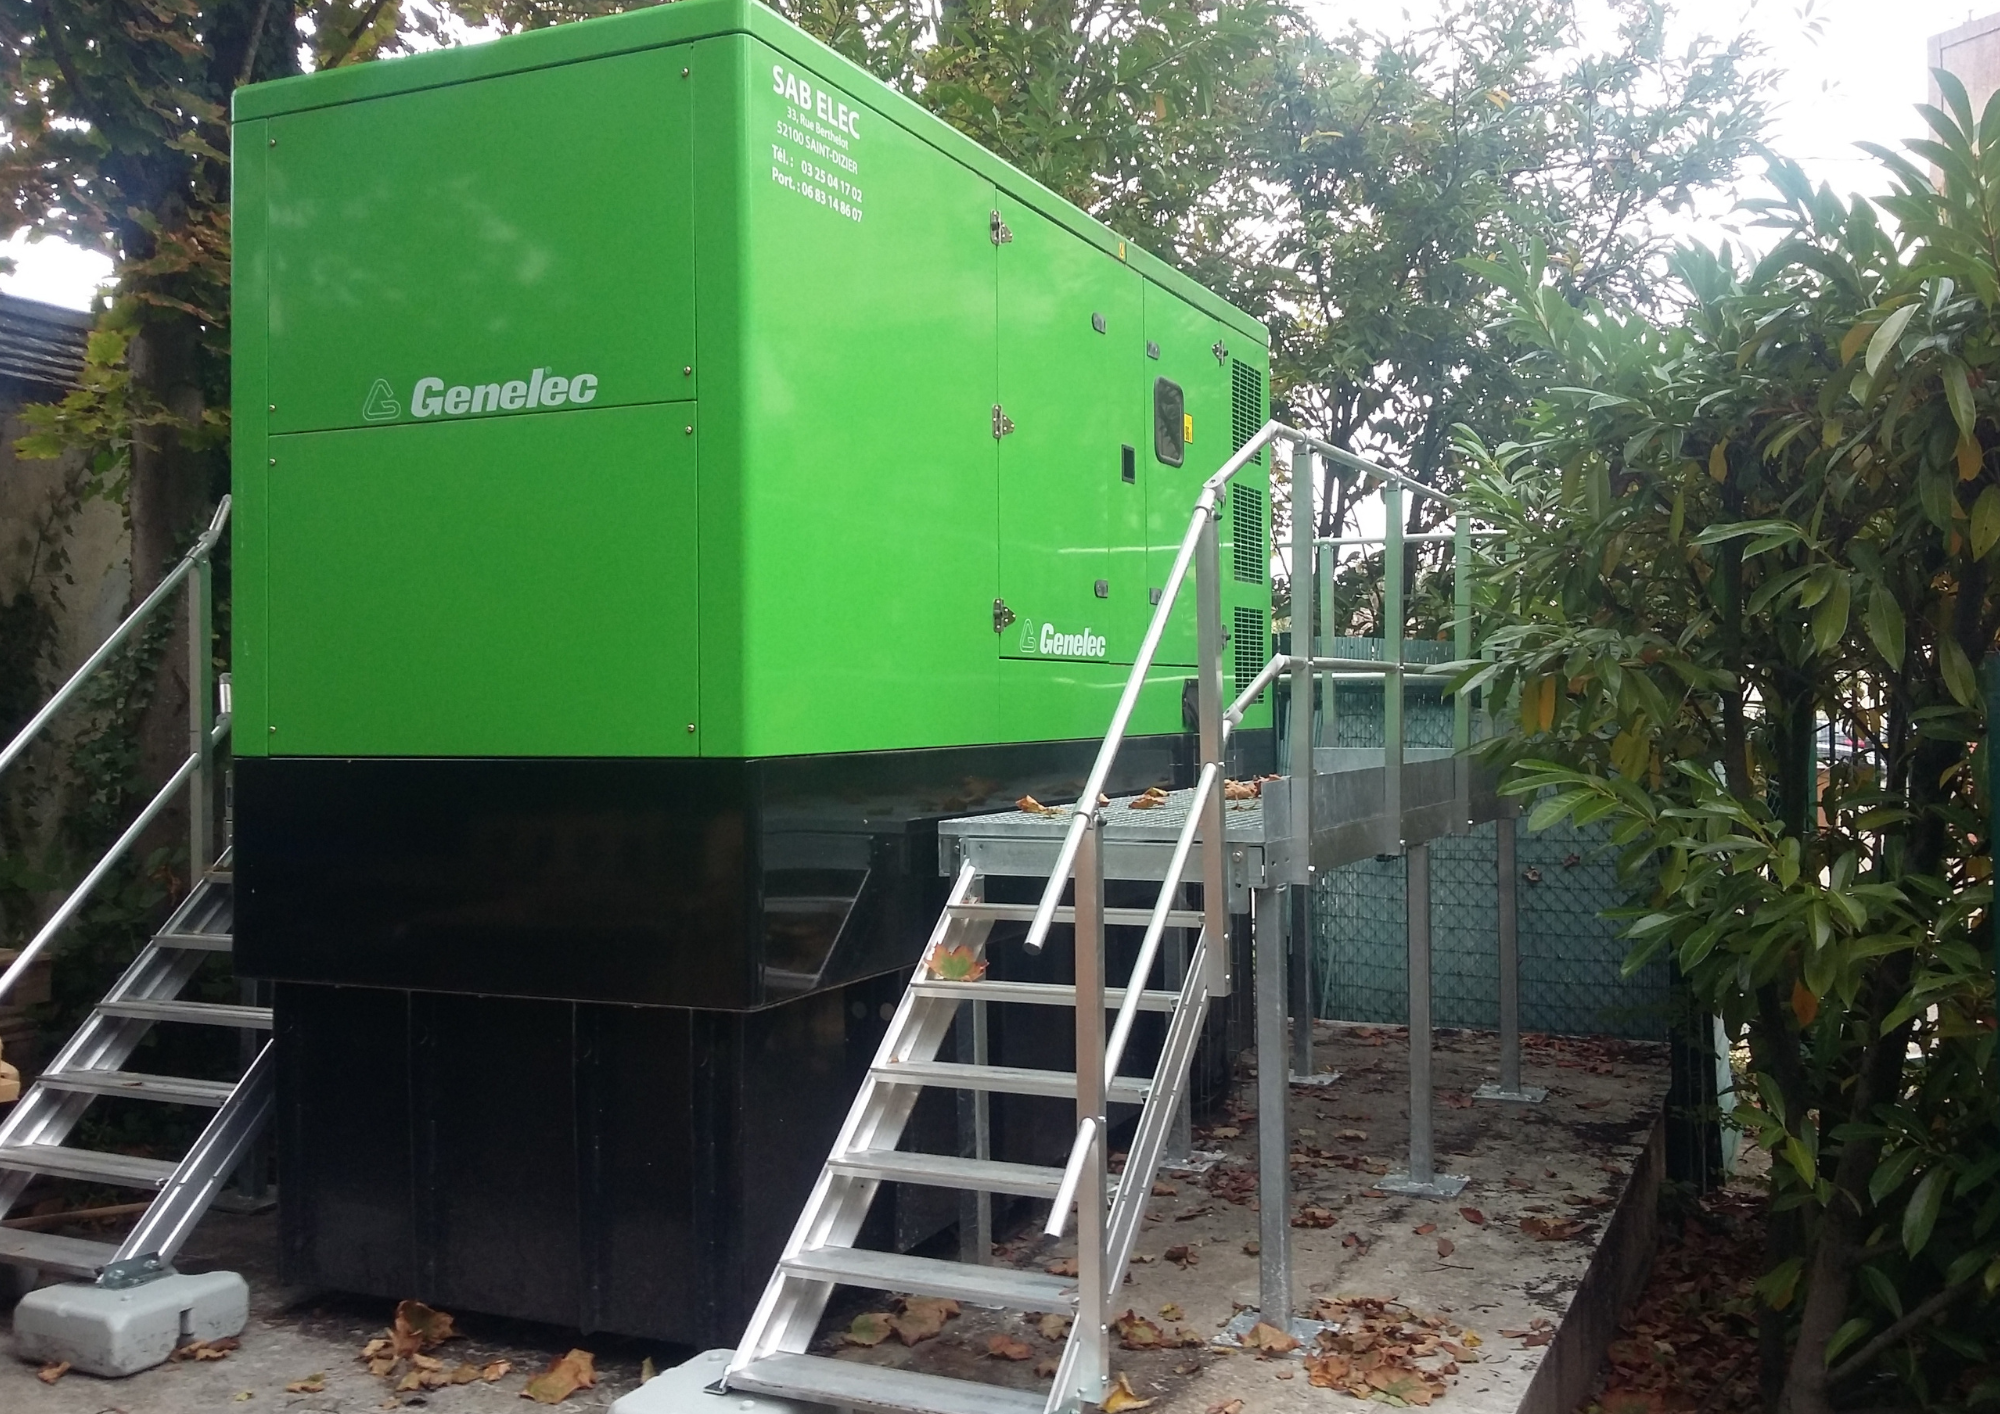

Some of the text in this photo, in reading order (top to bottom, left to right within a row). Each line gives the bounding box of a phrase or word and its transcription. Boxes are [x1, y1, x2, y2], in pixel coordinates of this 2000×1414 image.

[772, 65, 860, 140] SAB ELEC
[777, 120, 858, 175] 52100 SAINT-DIZIER
[787, 105, 849, 151] 33, Rue Berthelot
[801, 160, 813, 177] 03
[814, 167, 826, 184] 25
[827, 173, 839, 191] 04
[840, 180, 850, 196] 17
[851, 186, 862, 203] 02
[801, 182, 814, 199] 06
[814, 188, 826, 205] 83
[828, 195, 839, 211] 14
[840, 201, 851, 218] 86
[851, 207, 862, 222] 07
[411, 368, 598, 418] Genelec
[1040, 623, 1106, 657] Genelec
